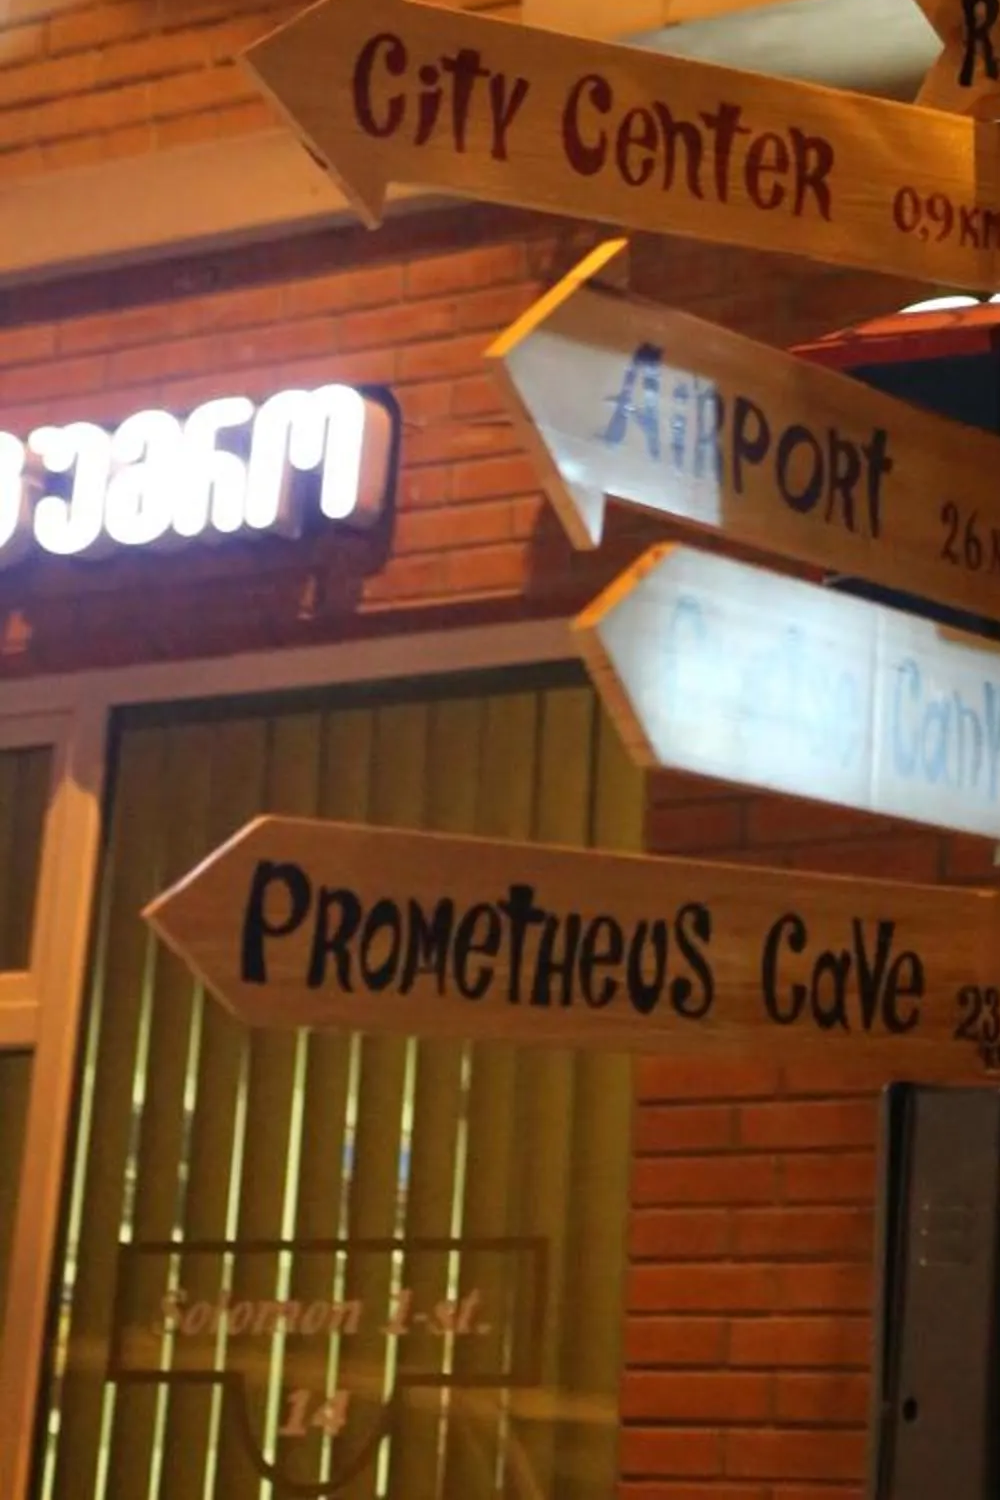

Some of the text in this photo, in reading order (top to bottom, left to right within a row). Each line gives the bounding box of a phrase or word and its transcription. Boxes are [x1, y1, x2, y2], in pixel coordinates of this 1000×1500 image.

[893, 183, 954, 243] 0,9
[940, 499, 982, 572] 26
[153, 1288, 363, 1336] Solomon
[279, 1389, 350, 1437] 14
